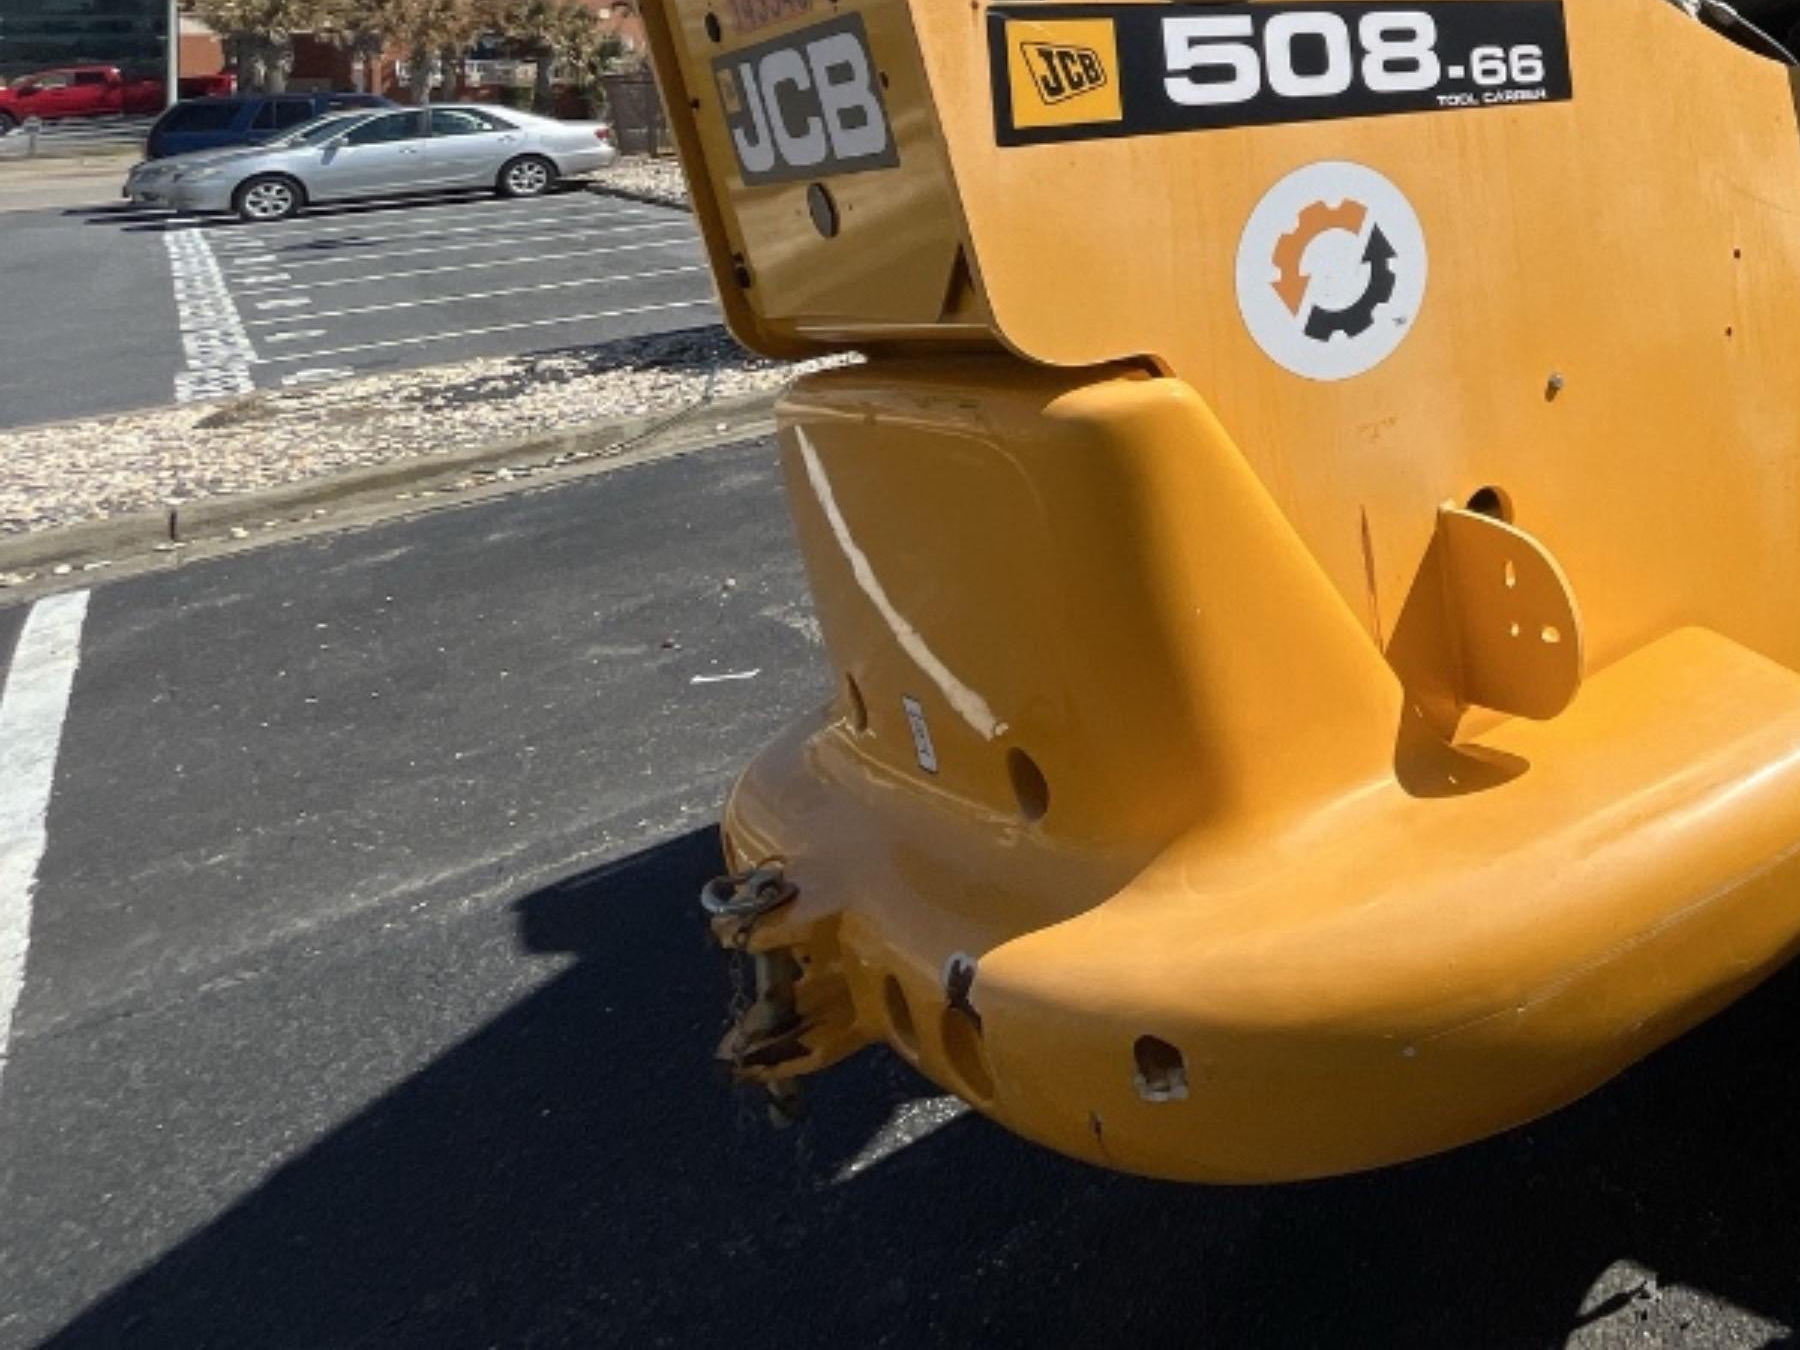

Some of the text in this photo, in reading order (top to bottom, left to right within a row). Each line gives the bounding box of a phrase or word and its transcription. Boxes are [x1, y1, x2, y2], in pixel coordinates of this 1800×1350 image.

[1036, 48, 1101, 96] JCB
[733, 32, 886, 172] JCB
[1436, 92, 1479, 106] TOOL
